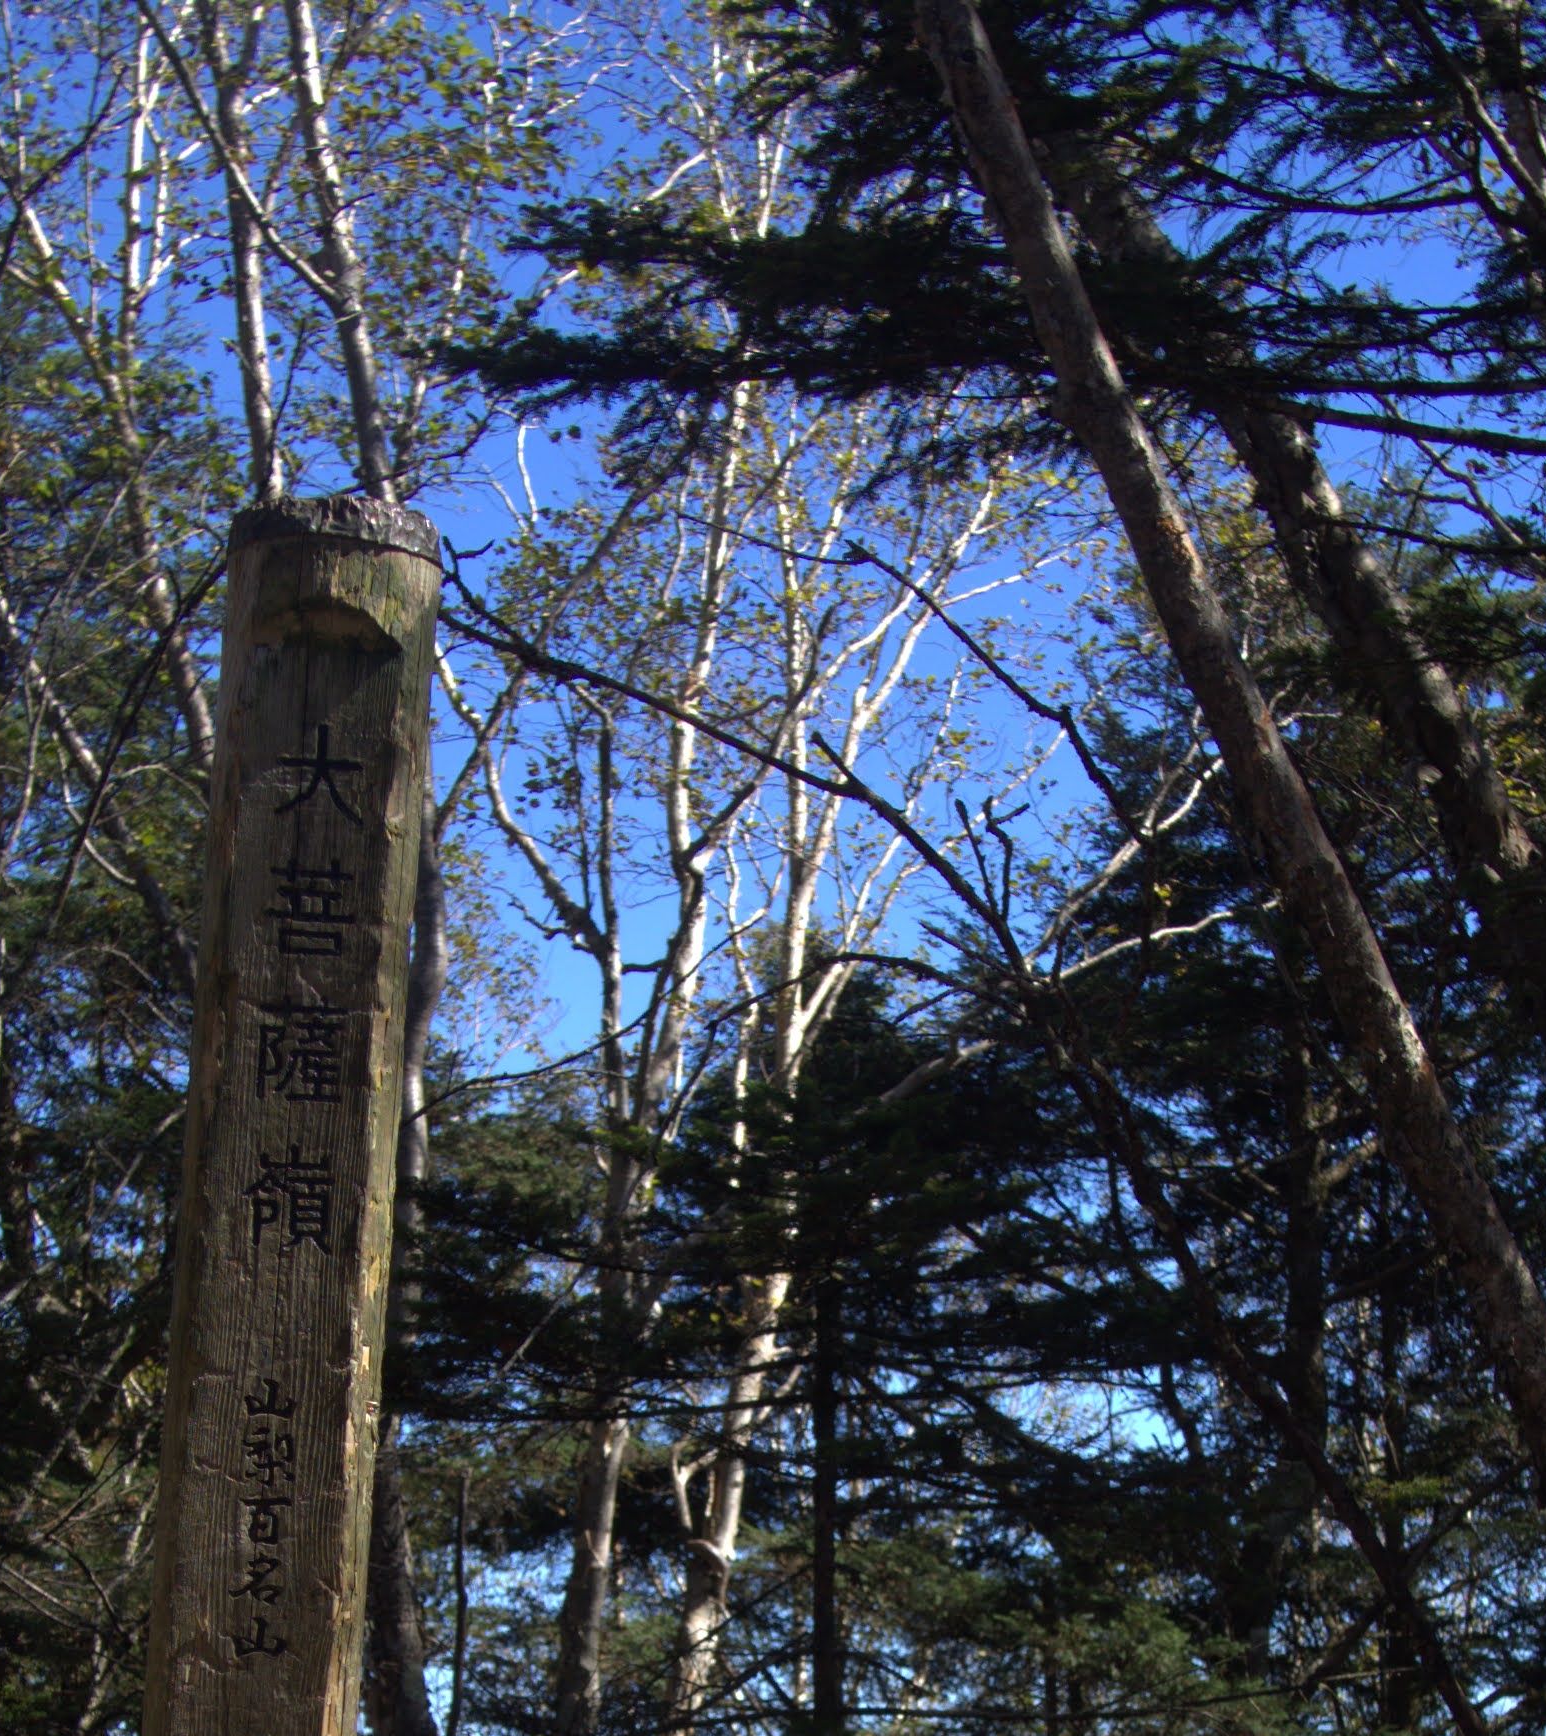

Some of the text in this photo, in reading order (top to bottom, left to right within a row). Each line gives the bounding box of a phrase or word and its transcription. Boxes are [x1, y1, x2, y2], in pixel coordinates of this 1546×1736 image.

[242, 723, 364, 1257] 大菩薩嶺
[228, 1378, 297, 1658] 山梨百名山
